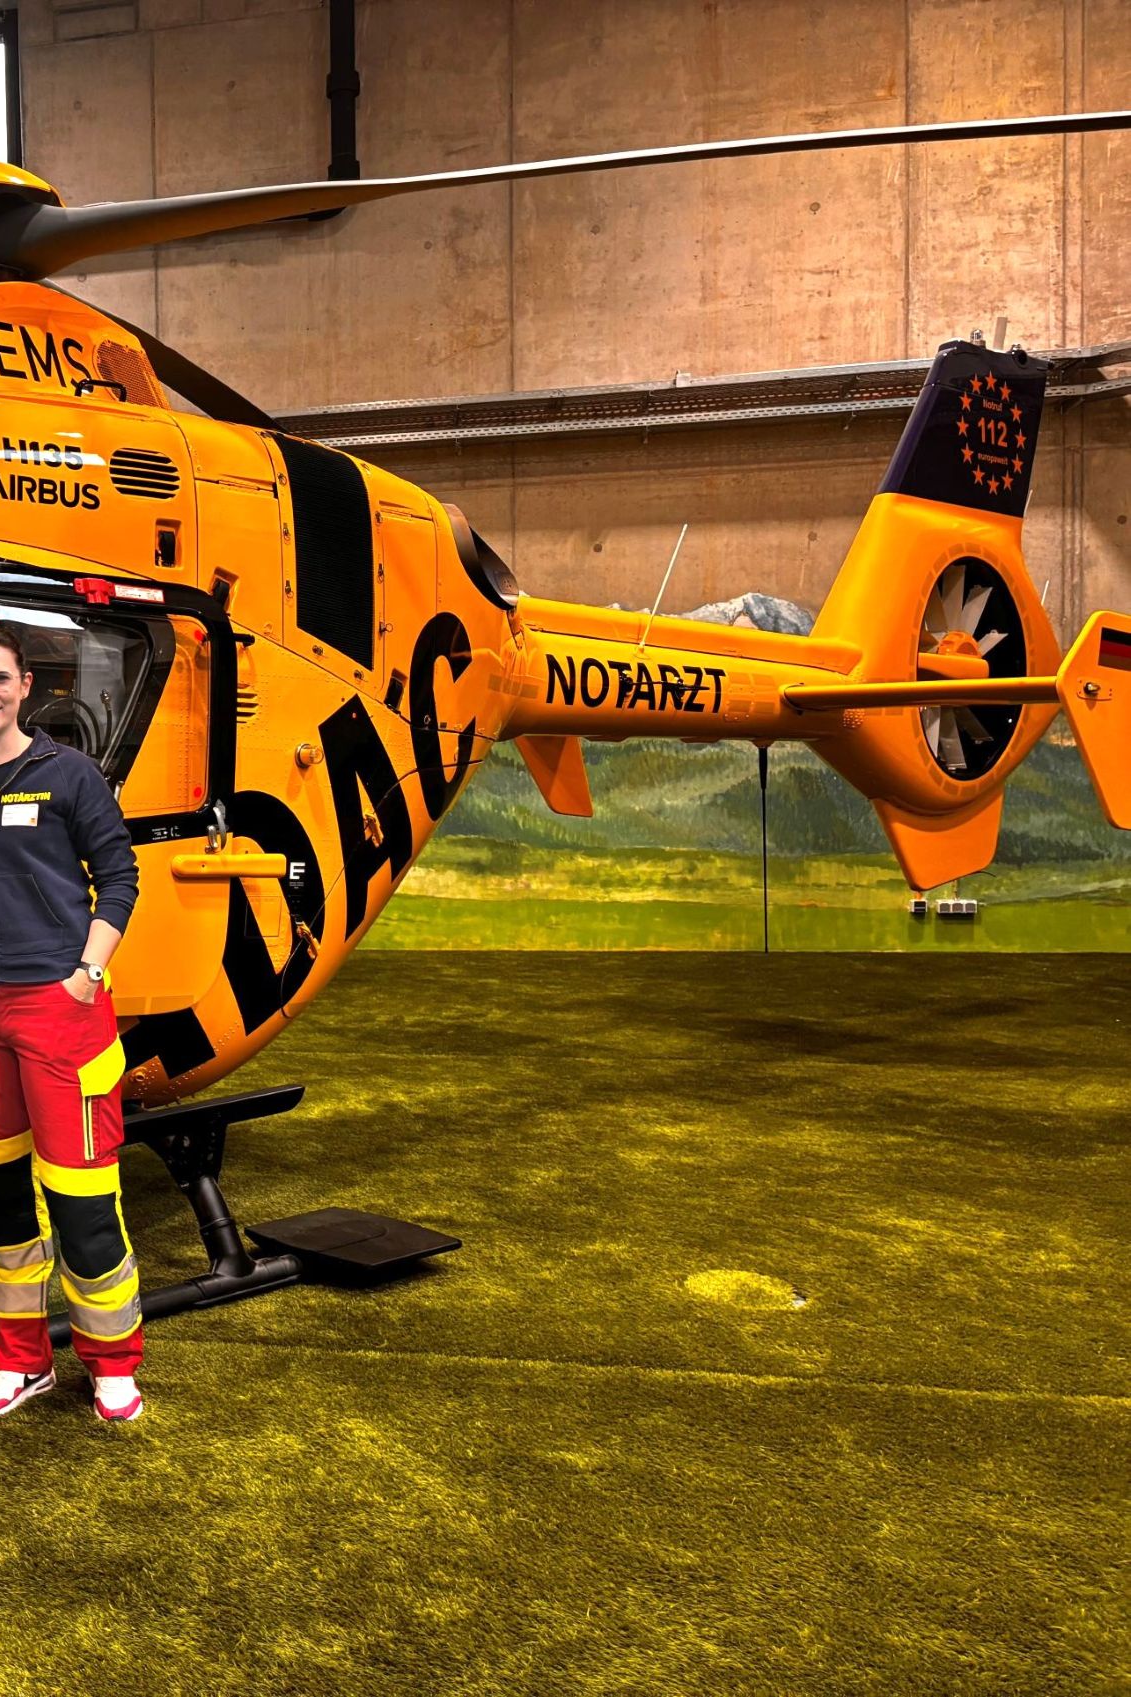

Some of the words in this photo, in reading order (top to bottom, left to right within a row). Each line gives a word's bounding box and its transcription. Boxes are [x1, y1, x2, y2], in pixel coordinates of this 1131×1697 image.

[977, 416, 1008, 448] 112
[2, 437, 84, 471] H135
[546, 654, 726, 714] NOTARZT
